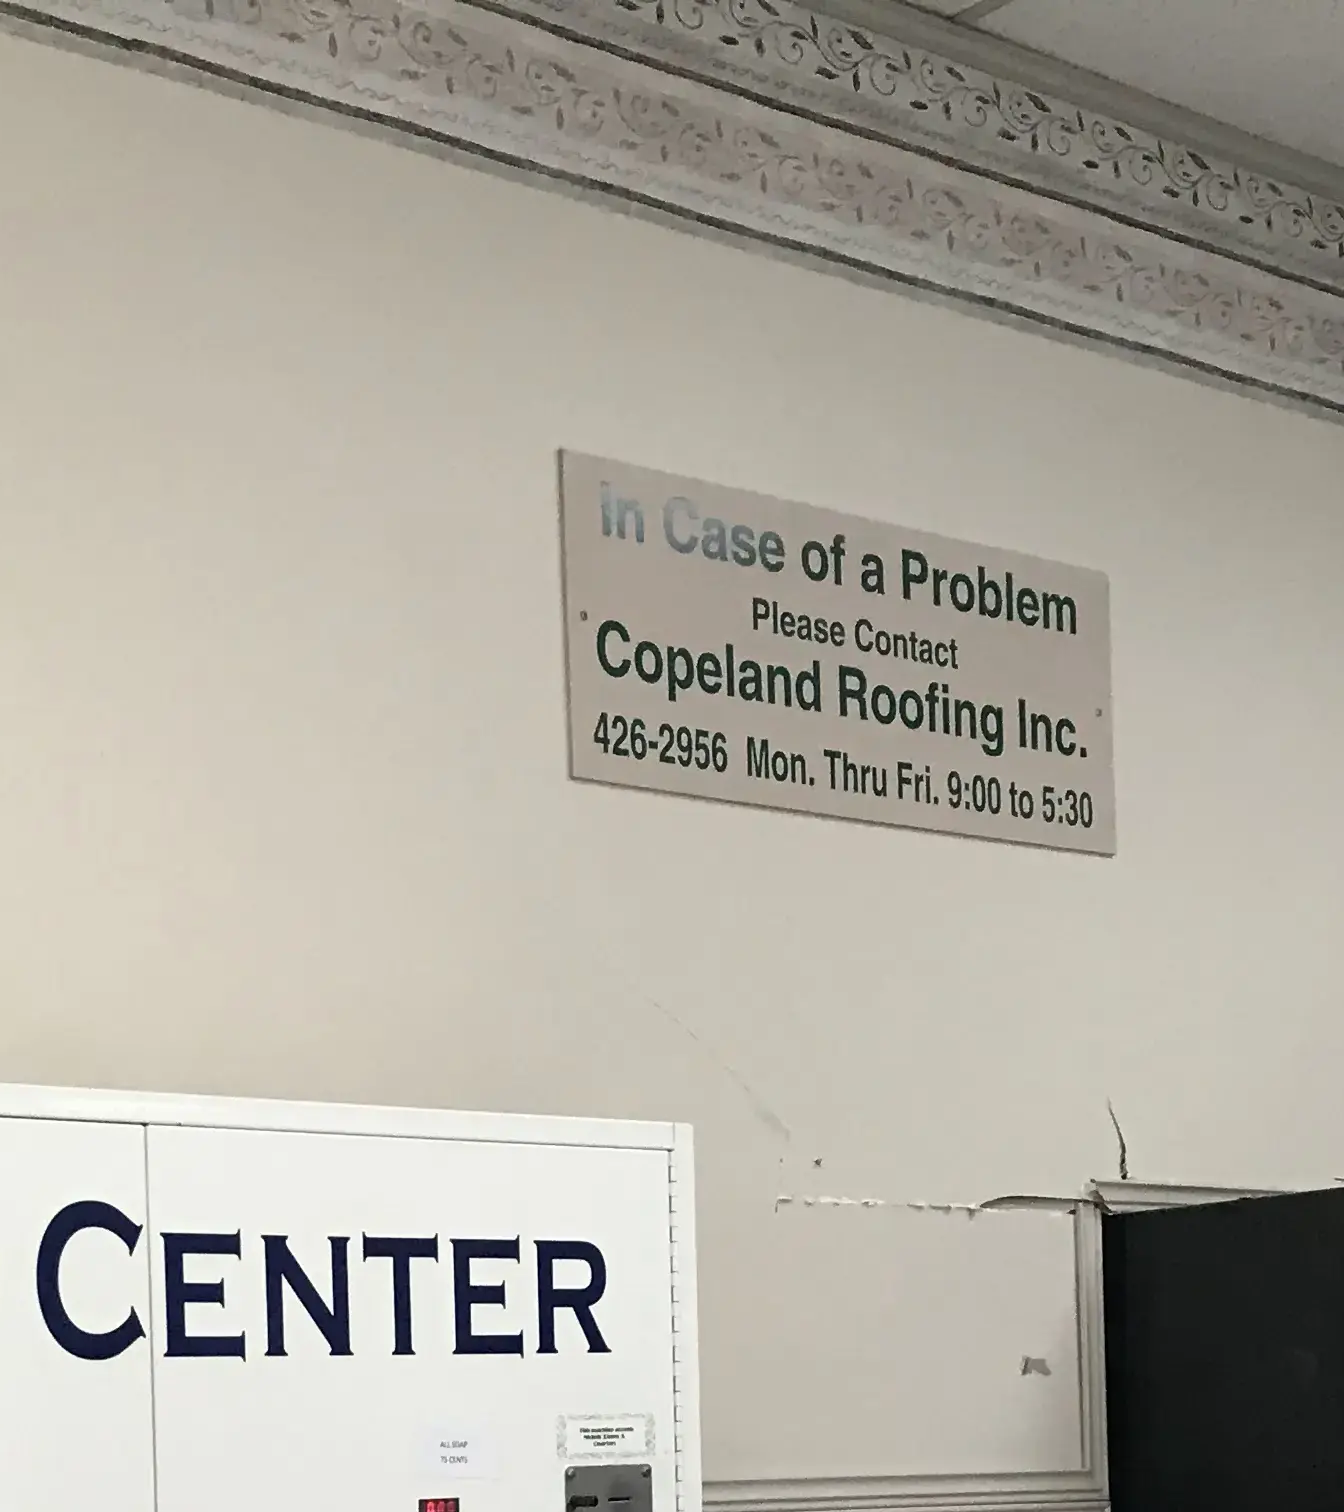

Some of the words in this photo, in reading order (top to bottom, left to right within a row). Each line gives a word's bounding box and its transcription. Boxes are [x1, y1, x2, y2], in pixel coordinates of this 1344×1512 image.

[662, 497, 785, 572] Case
[801, 534, 845, 585] of
[861, 555, 885, 594] a
[902, 549, 1077, 634] Problem
[752, 598, 845, 647] Please
[855, 619, 959, 669] Contact
[596, 620, 822, 712] Copeland
[839, 665, 1004, 757] Roofing
[1018, 698, 1088, 758] Inc.
[593, 713, 728, 772] 426-2956
[746, 736, 814, 786] Mon.
[824, 749, 887, 797] Thru
[897, 763, 939, 805] Fri.
[948, 777, 1001, 815] 9:00
[1009, 788, 1034, 819] to
[1042, 787, 1094, 828] 5:30
[36, 1200, 611, 1363] CENTER
